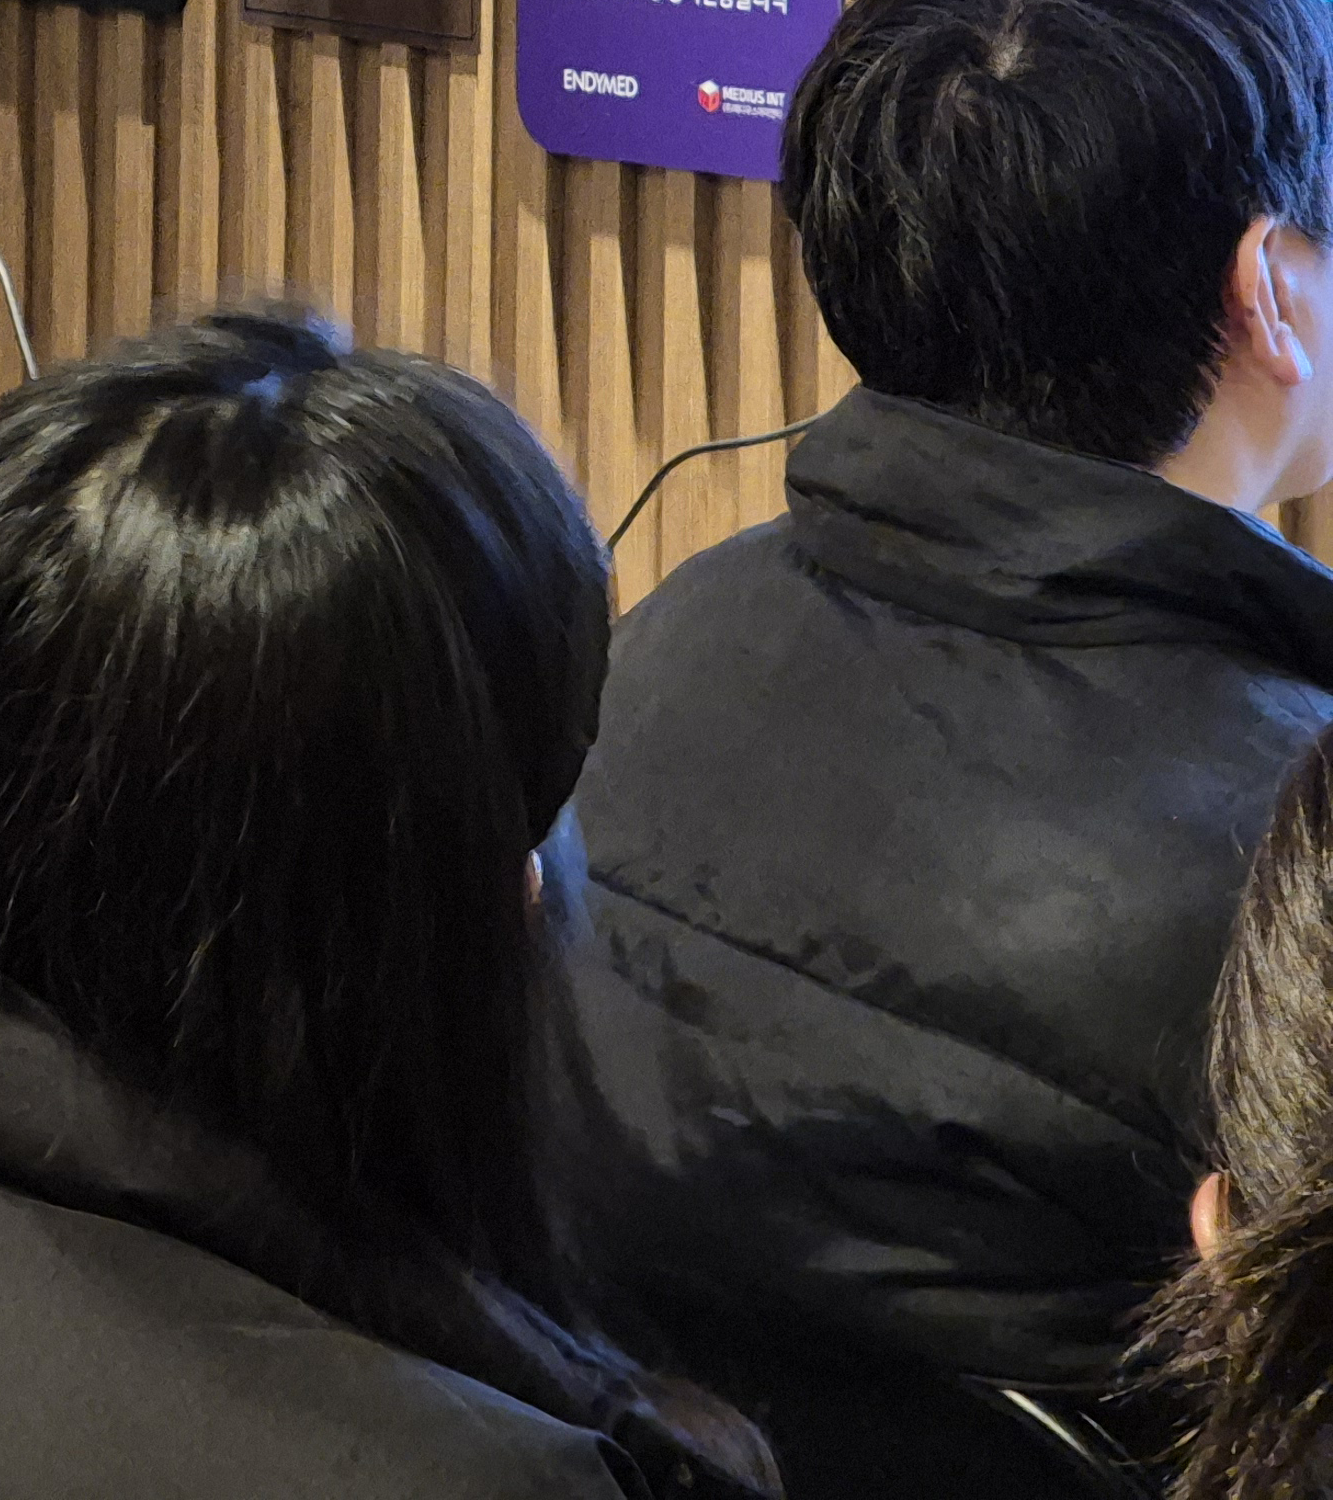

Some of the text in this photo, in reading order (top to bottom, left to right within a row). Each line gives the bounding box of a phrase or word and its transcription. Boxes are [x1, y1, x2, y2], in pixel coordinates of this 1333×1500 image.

[562, 67, 639, 99] ENDYMED
[722, 85, 786, 108] MEDIUS INT
